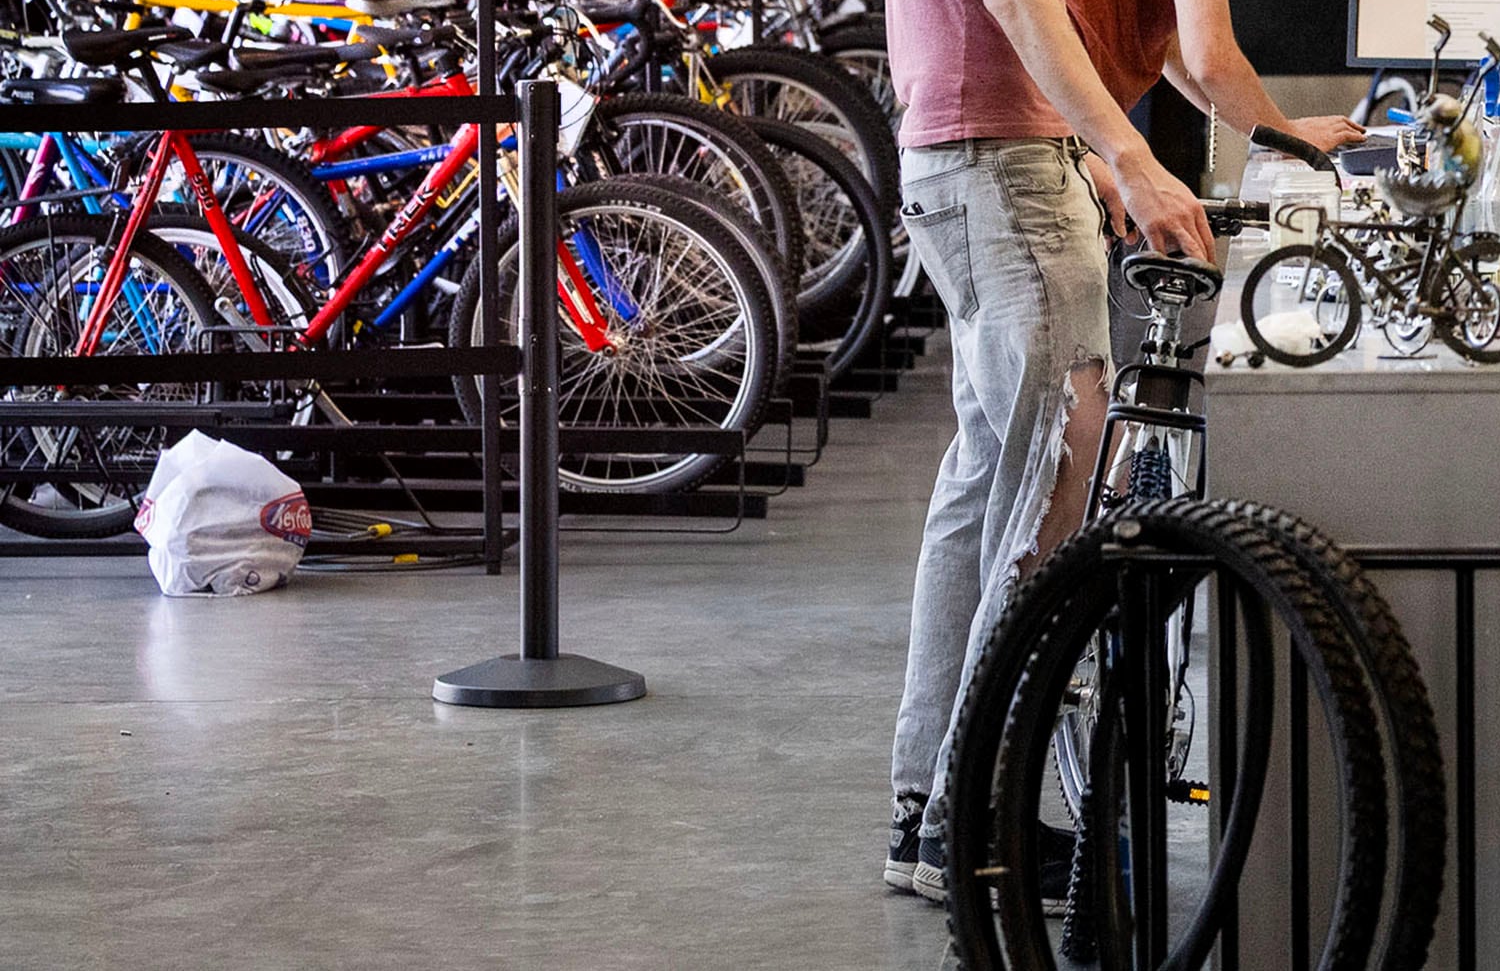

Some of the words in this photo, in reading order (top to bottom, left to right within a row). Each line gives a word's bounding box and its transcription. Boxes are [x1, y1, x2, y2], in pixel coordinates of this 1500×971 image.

[192, 173, 215, 211] 990
[296, 215, 317, 252] 830
[376, 182, 439, 253] TREK
